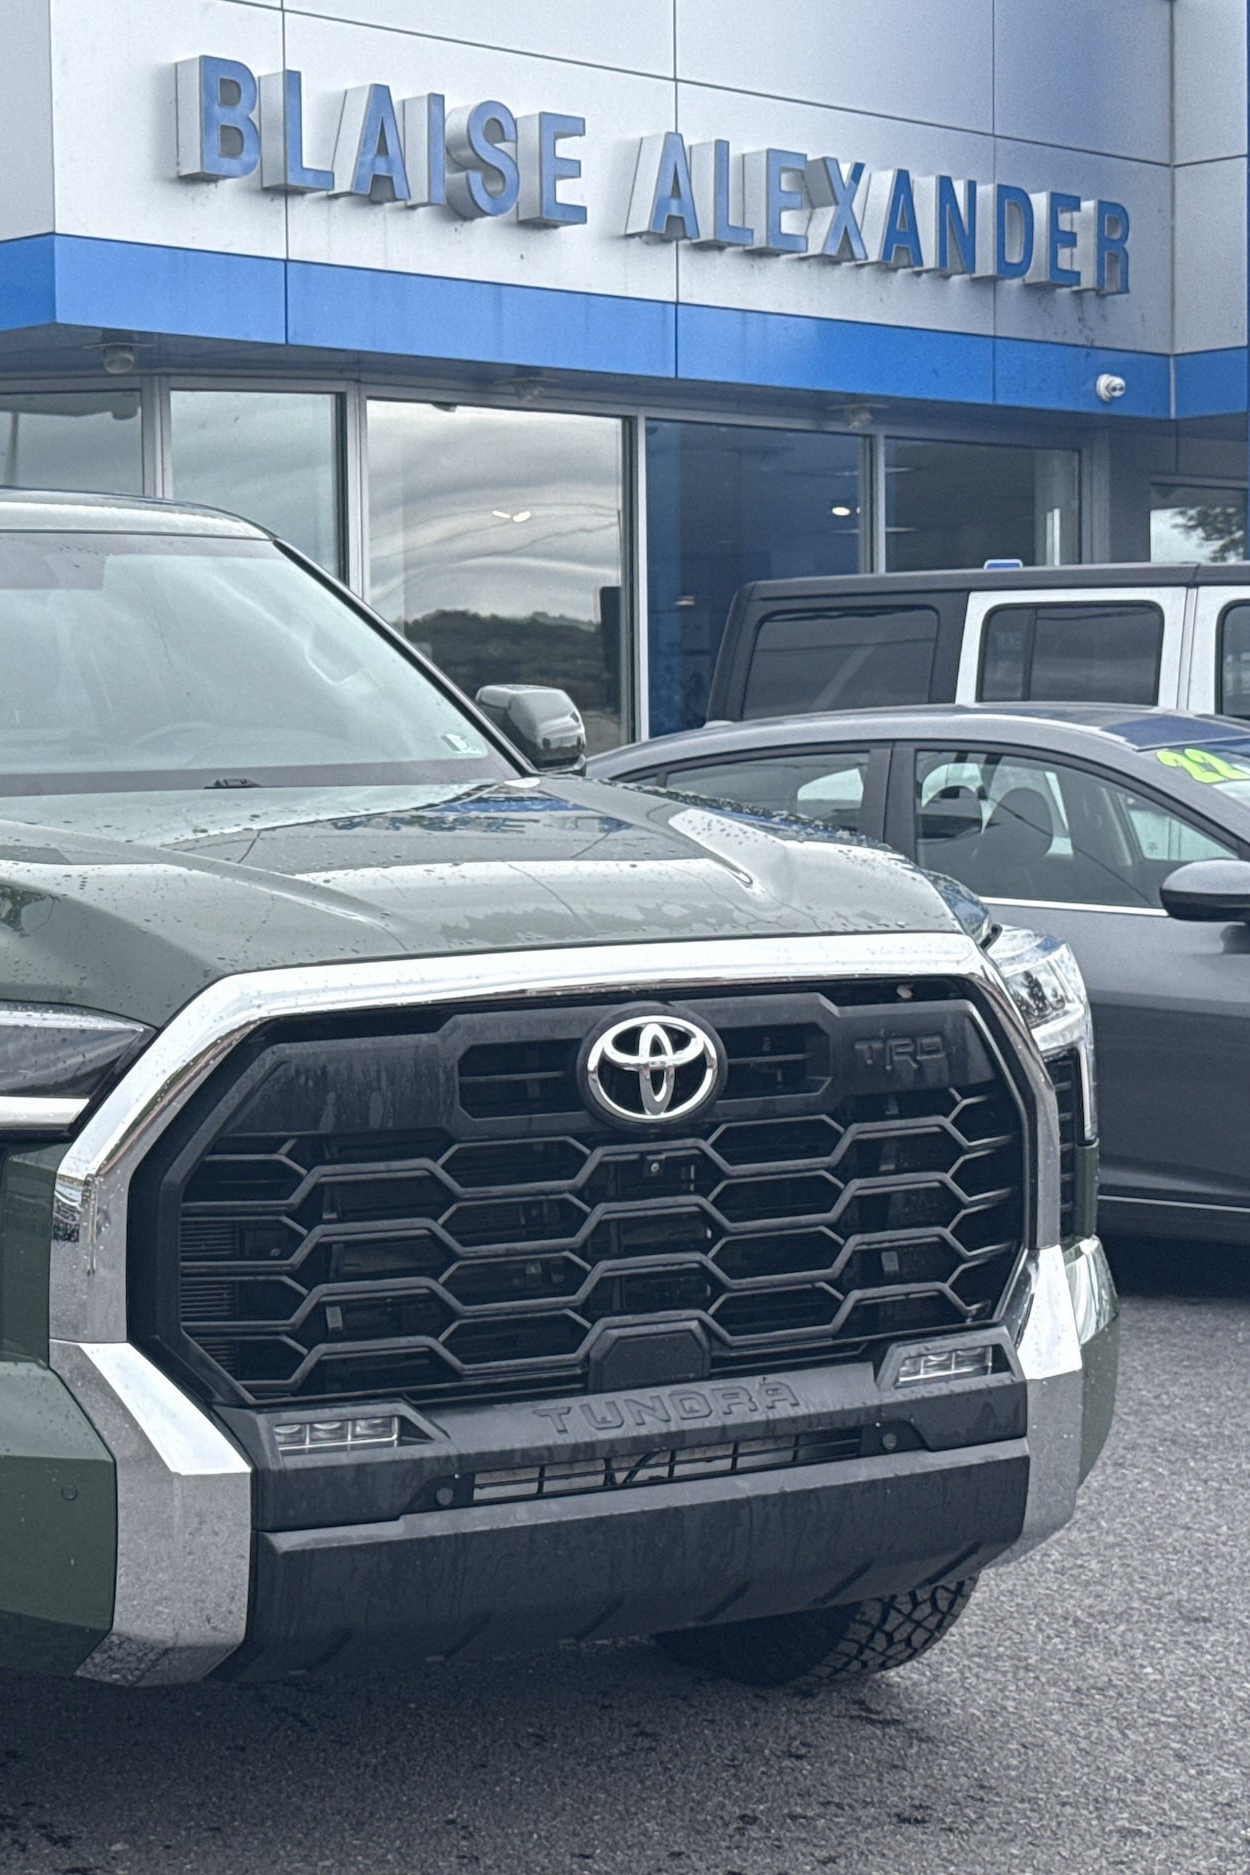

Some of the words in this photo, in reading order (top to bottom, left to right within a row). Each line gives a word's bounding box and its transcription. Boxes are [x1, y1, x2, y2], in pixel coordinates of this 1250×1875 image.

[175, 55, 588, 227] BLAISE
[628, 132, 1131, 294] ALEXANDER
[1156, 747, 1250, 784] 22
[854, 1034, 946, 1071] TRD
[534, 1381, 800, 1434] TUNDRA
